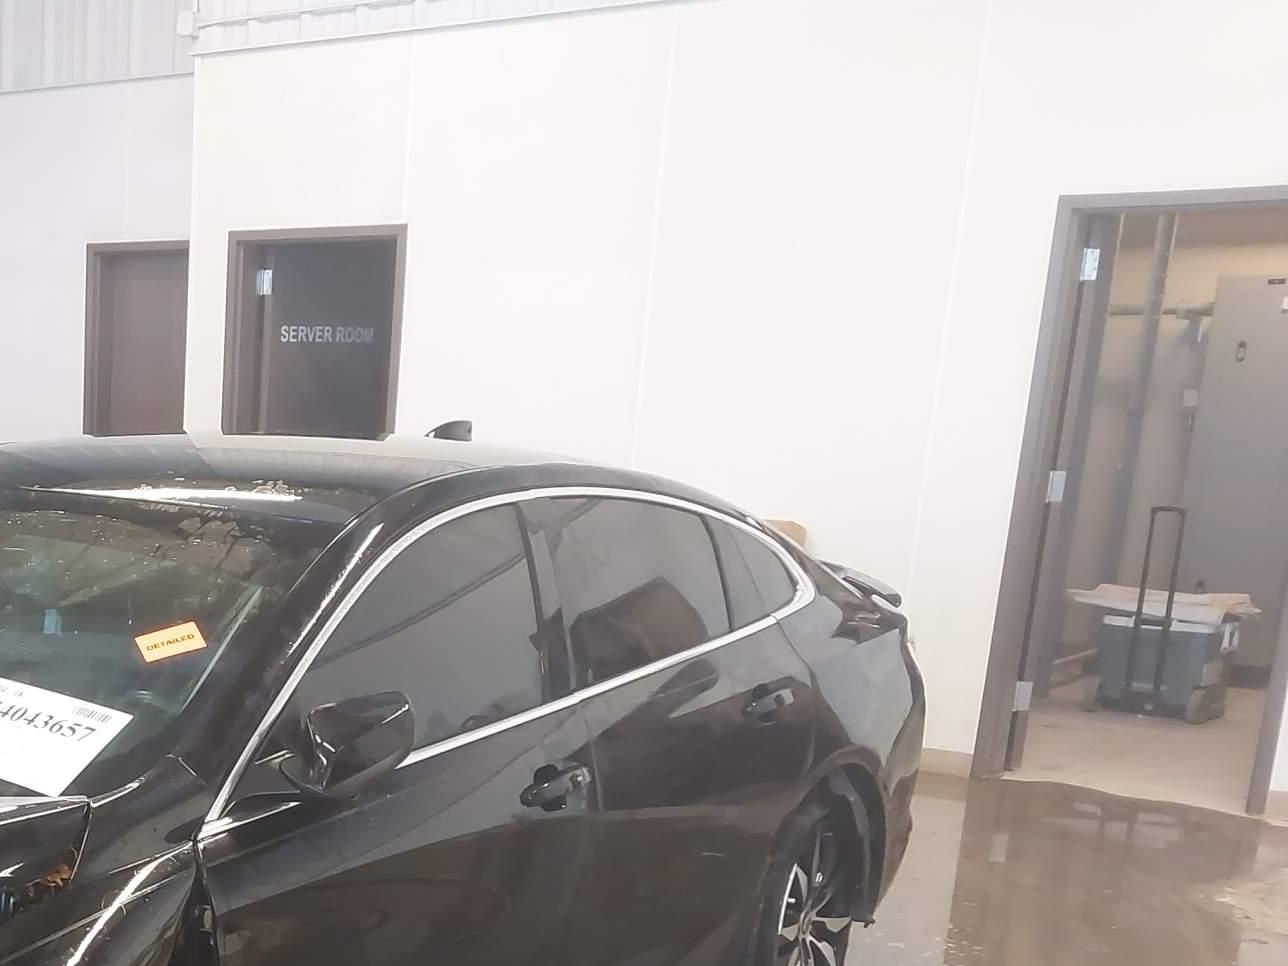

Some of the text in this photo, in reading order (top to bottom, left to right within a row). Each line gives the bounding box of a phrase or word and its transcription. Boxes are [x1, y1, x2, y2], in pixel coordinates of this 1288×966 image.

[280, 325, 374, 343] SERVER ROOM
[146, 633, 195, 651] DETAILED
